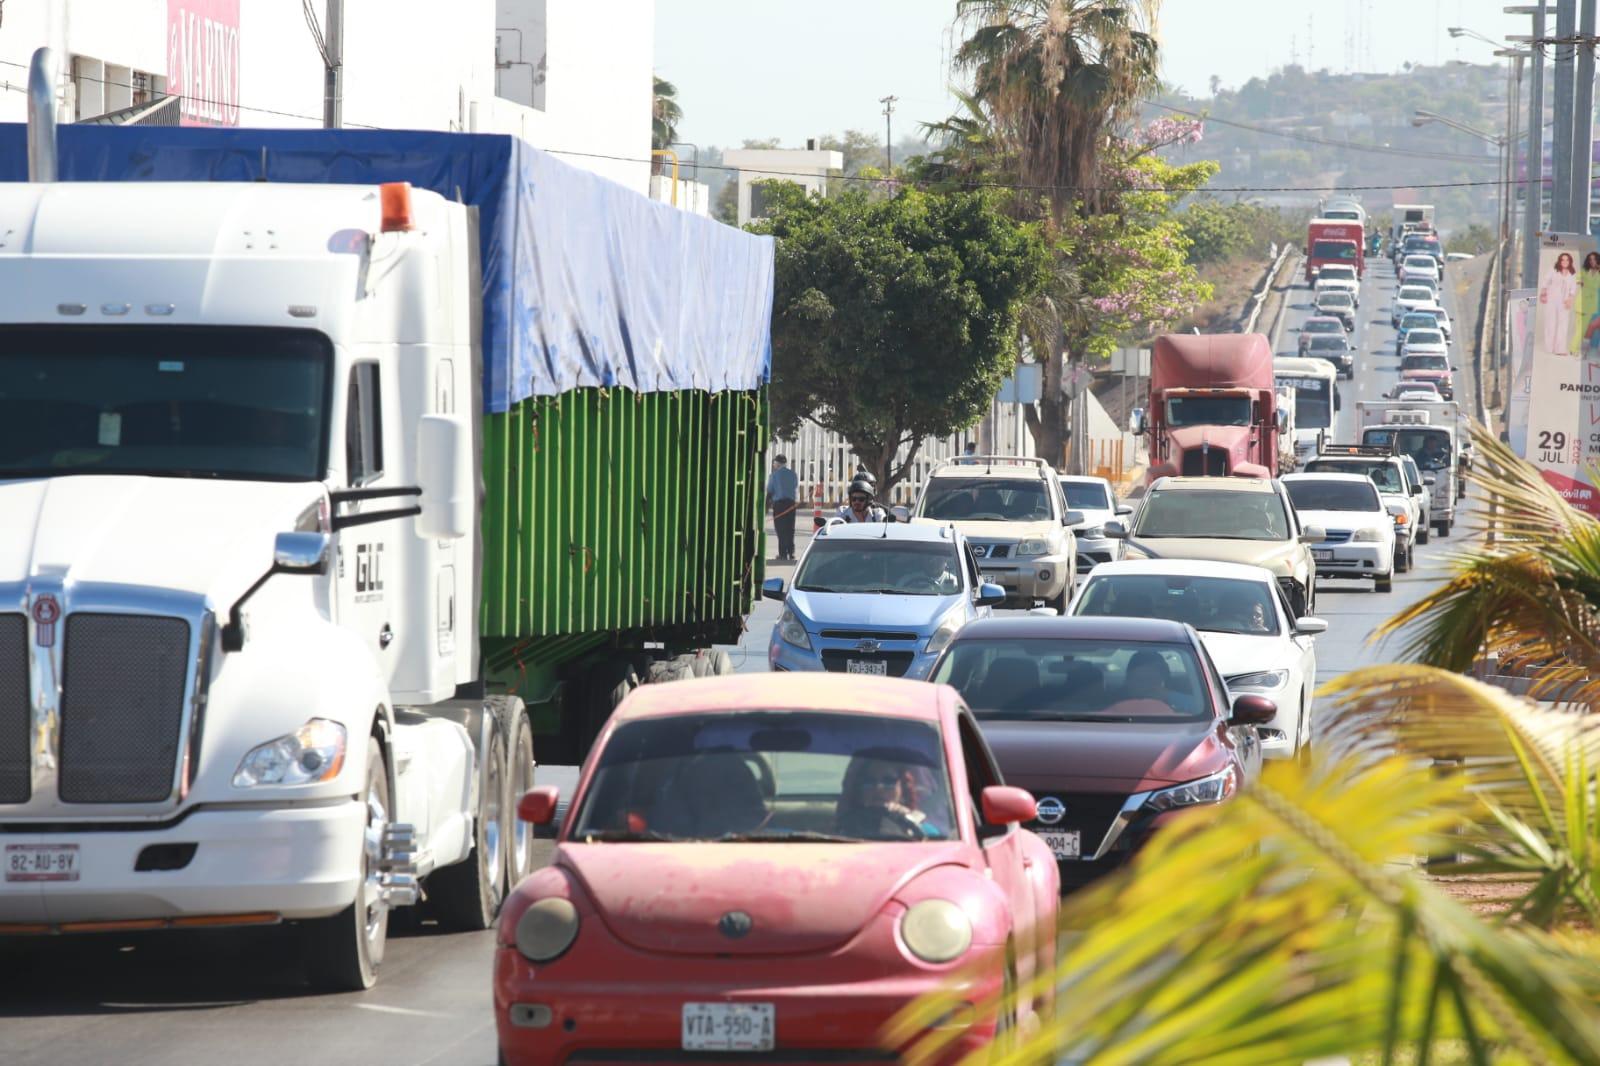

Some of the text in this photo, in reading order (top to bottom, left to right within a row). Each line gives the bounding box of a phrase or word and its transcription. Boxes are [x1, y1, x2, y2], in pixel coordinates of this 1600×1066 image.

[1538, 431, 1565, 450] 29
[1538, 451, 1565, 464] JUL
[1571, 439, 1581, 464] 2023
[687, 1014, 771, 1036] VTA-550-A
